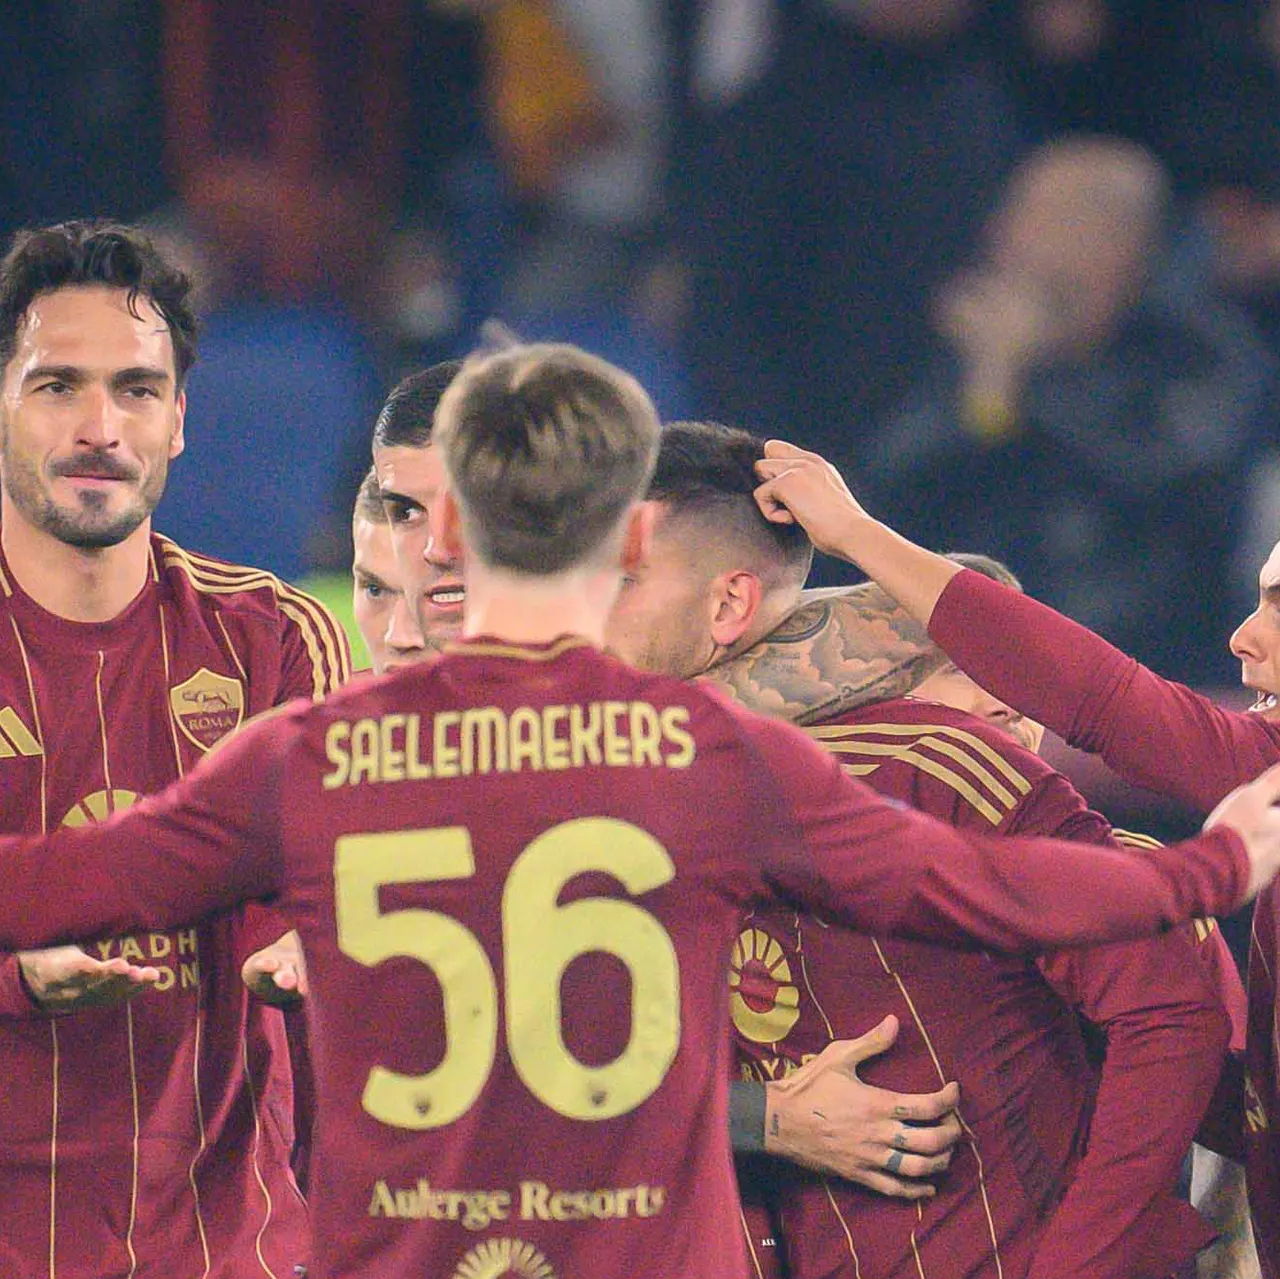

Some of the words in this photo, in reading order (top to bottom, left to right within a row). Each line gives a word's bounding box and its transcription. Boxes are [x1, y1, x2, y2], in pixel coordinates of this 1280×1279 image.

[188, 715, 234, 731] ROMA
[323, 701, 697, 790] SAELEMAEKERS
[97, 929, 197, 961] YADH
[334, 815, 681, 1131] 56
